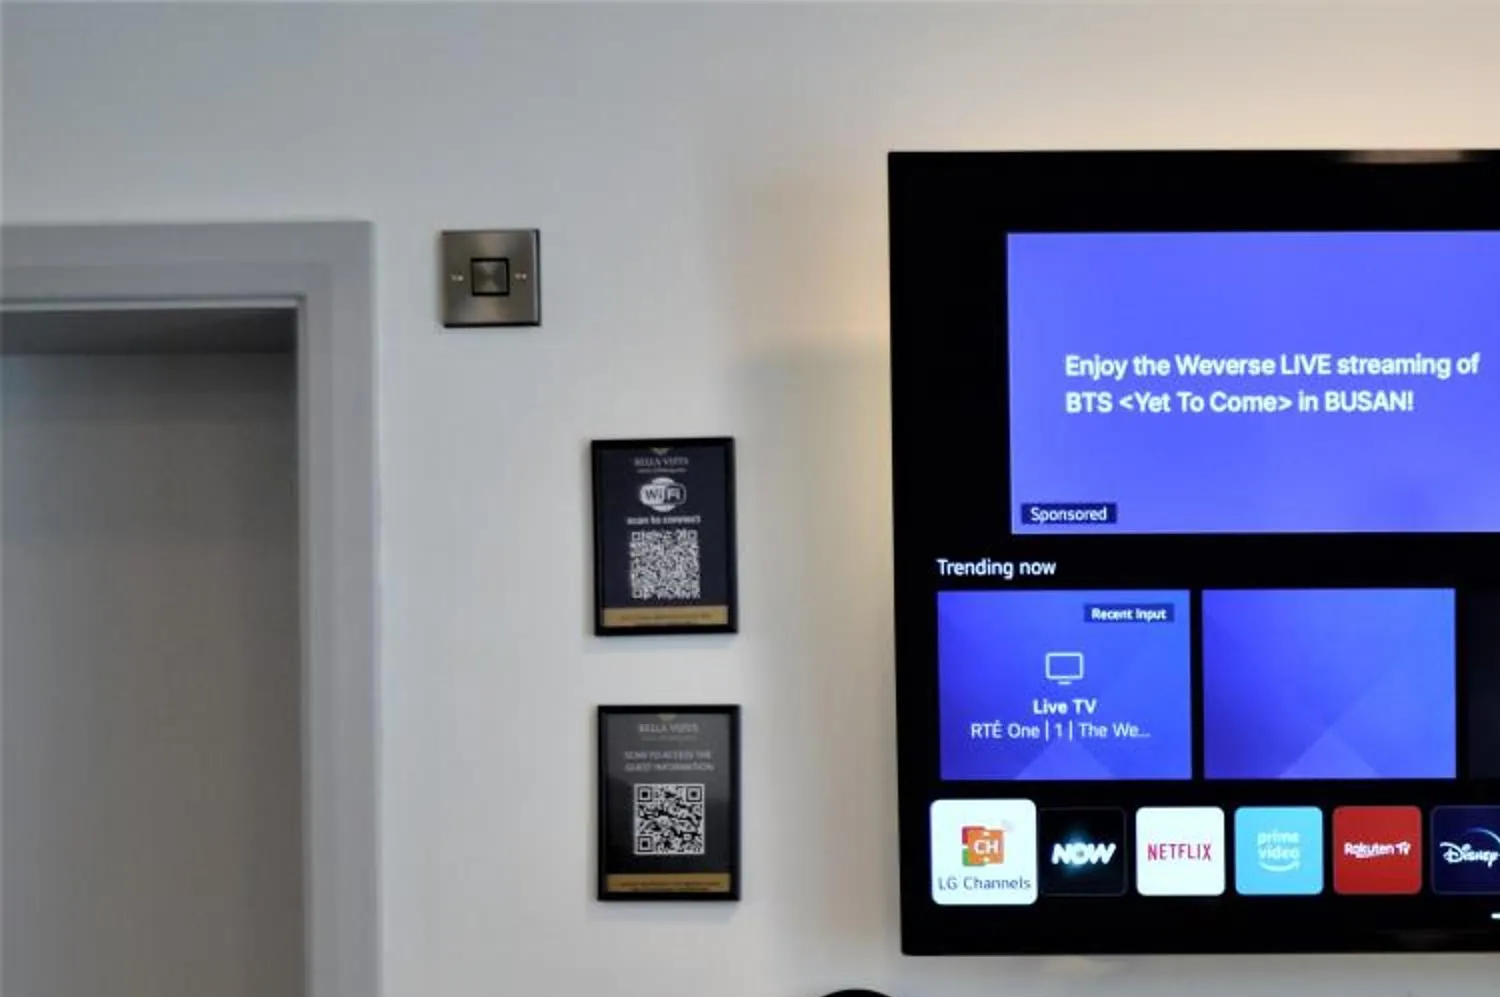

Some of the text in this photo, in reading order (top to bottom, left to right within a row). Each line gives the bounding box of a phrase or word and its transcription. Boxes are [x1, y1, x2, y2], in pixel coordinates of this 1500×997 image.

[1065, 352, 1481, 381] Enjoy the Weverse LIVE streaming of
[1066, 390, 1415, 413] BTS <Yet To Come> in BUSAN!
[1030, 506, 1108, 523] Sponsored
[937, 558, 1056, 580] Trending now
[1091, 607, 1167, 622] Recent Input
[1033, 699, 1097, 715] Live TV
[971, 719, 1002, 739] RTÉ
[1007, 723, 1040, 739] One
[1079, 722, 1108, 738] The
[973, 839, 999, 855] CH
[1257, 830, 1300, 847] prime
[1051, 842, 1117, 865] NOW
[1147, 843, 1212, 862] NETFLIX
[1257, 846, 1301, 859] video
[1343, 842, 1395, 857] Rakuten
[938, 875, 1031, 890] LG Channels
